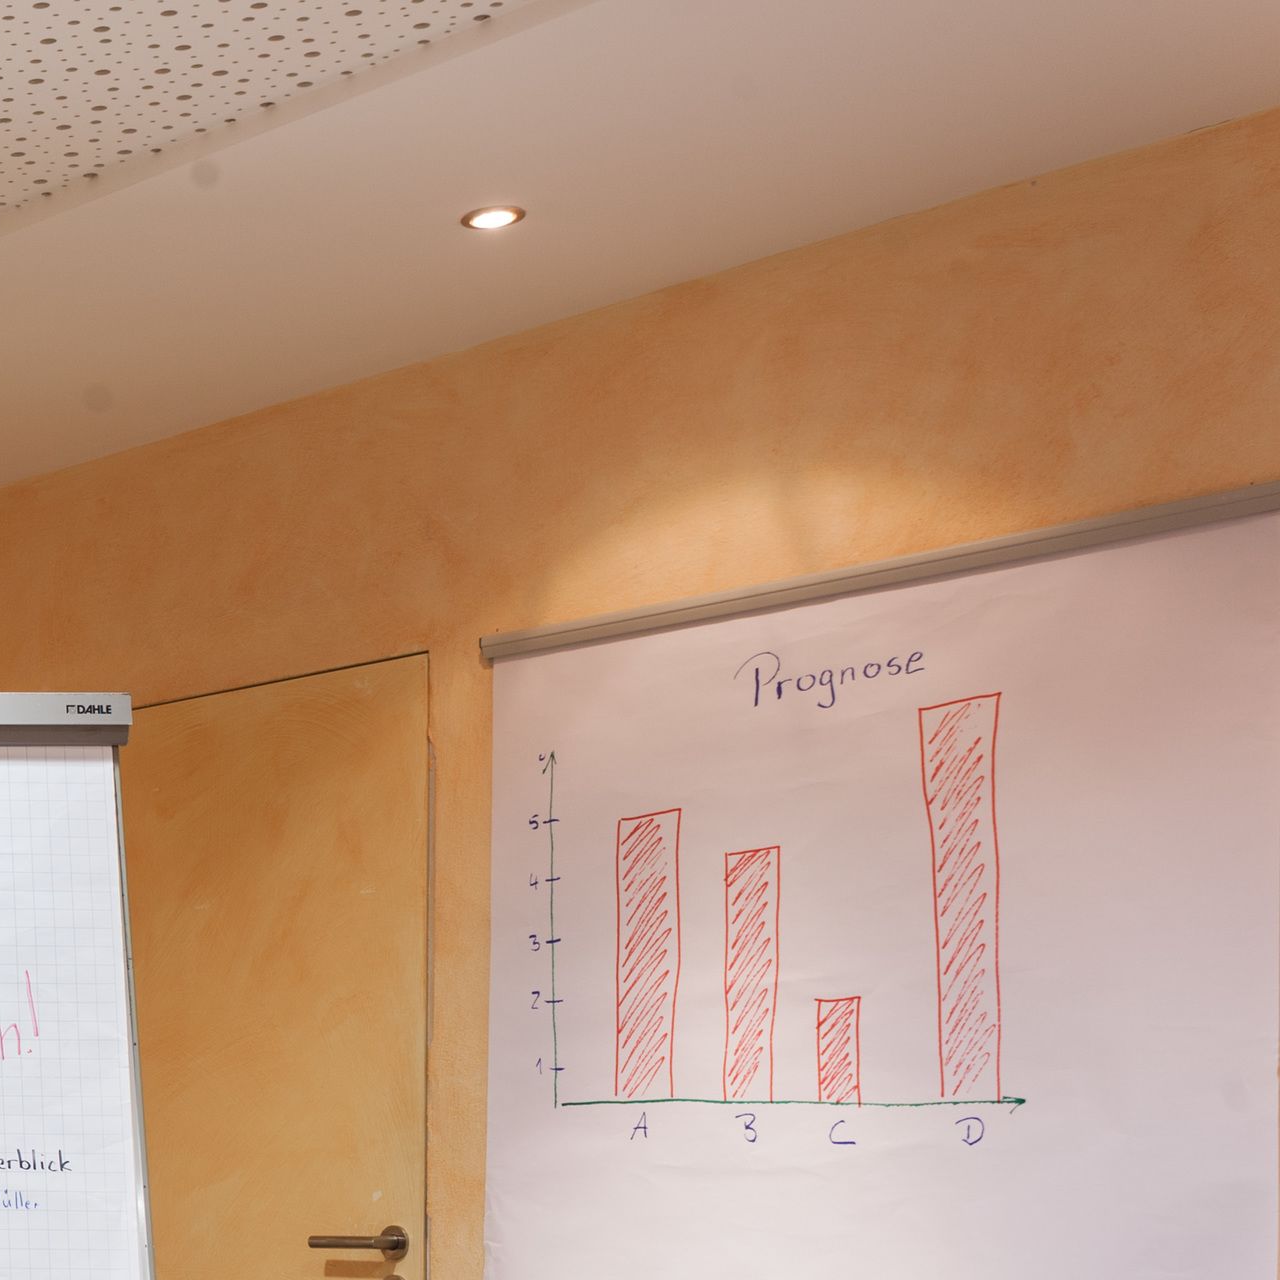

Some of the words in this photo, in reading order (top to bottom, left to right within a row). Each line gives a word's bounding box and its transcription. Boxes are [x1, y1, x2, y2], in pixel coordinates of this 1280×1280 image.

[734, 650, 926, 708] Prognose
[77, 704, 112, 715] DAHLE
[528, 814, 539, 829] 5
[529, 874, 539, 890] 4
[529, 935, 541, 952] 3
[531, 991, 541, 1009] 2
[535, 1058, 542, 1075] 1
[630, 1112, 649, 1141] A
[735, 1112, 759, 1145] B
[829, 1119, 857, 1145] C
[955, 1116, 985, 1146] D
